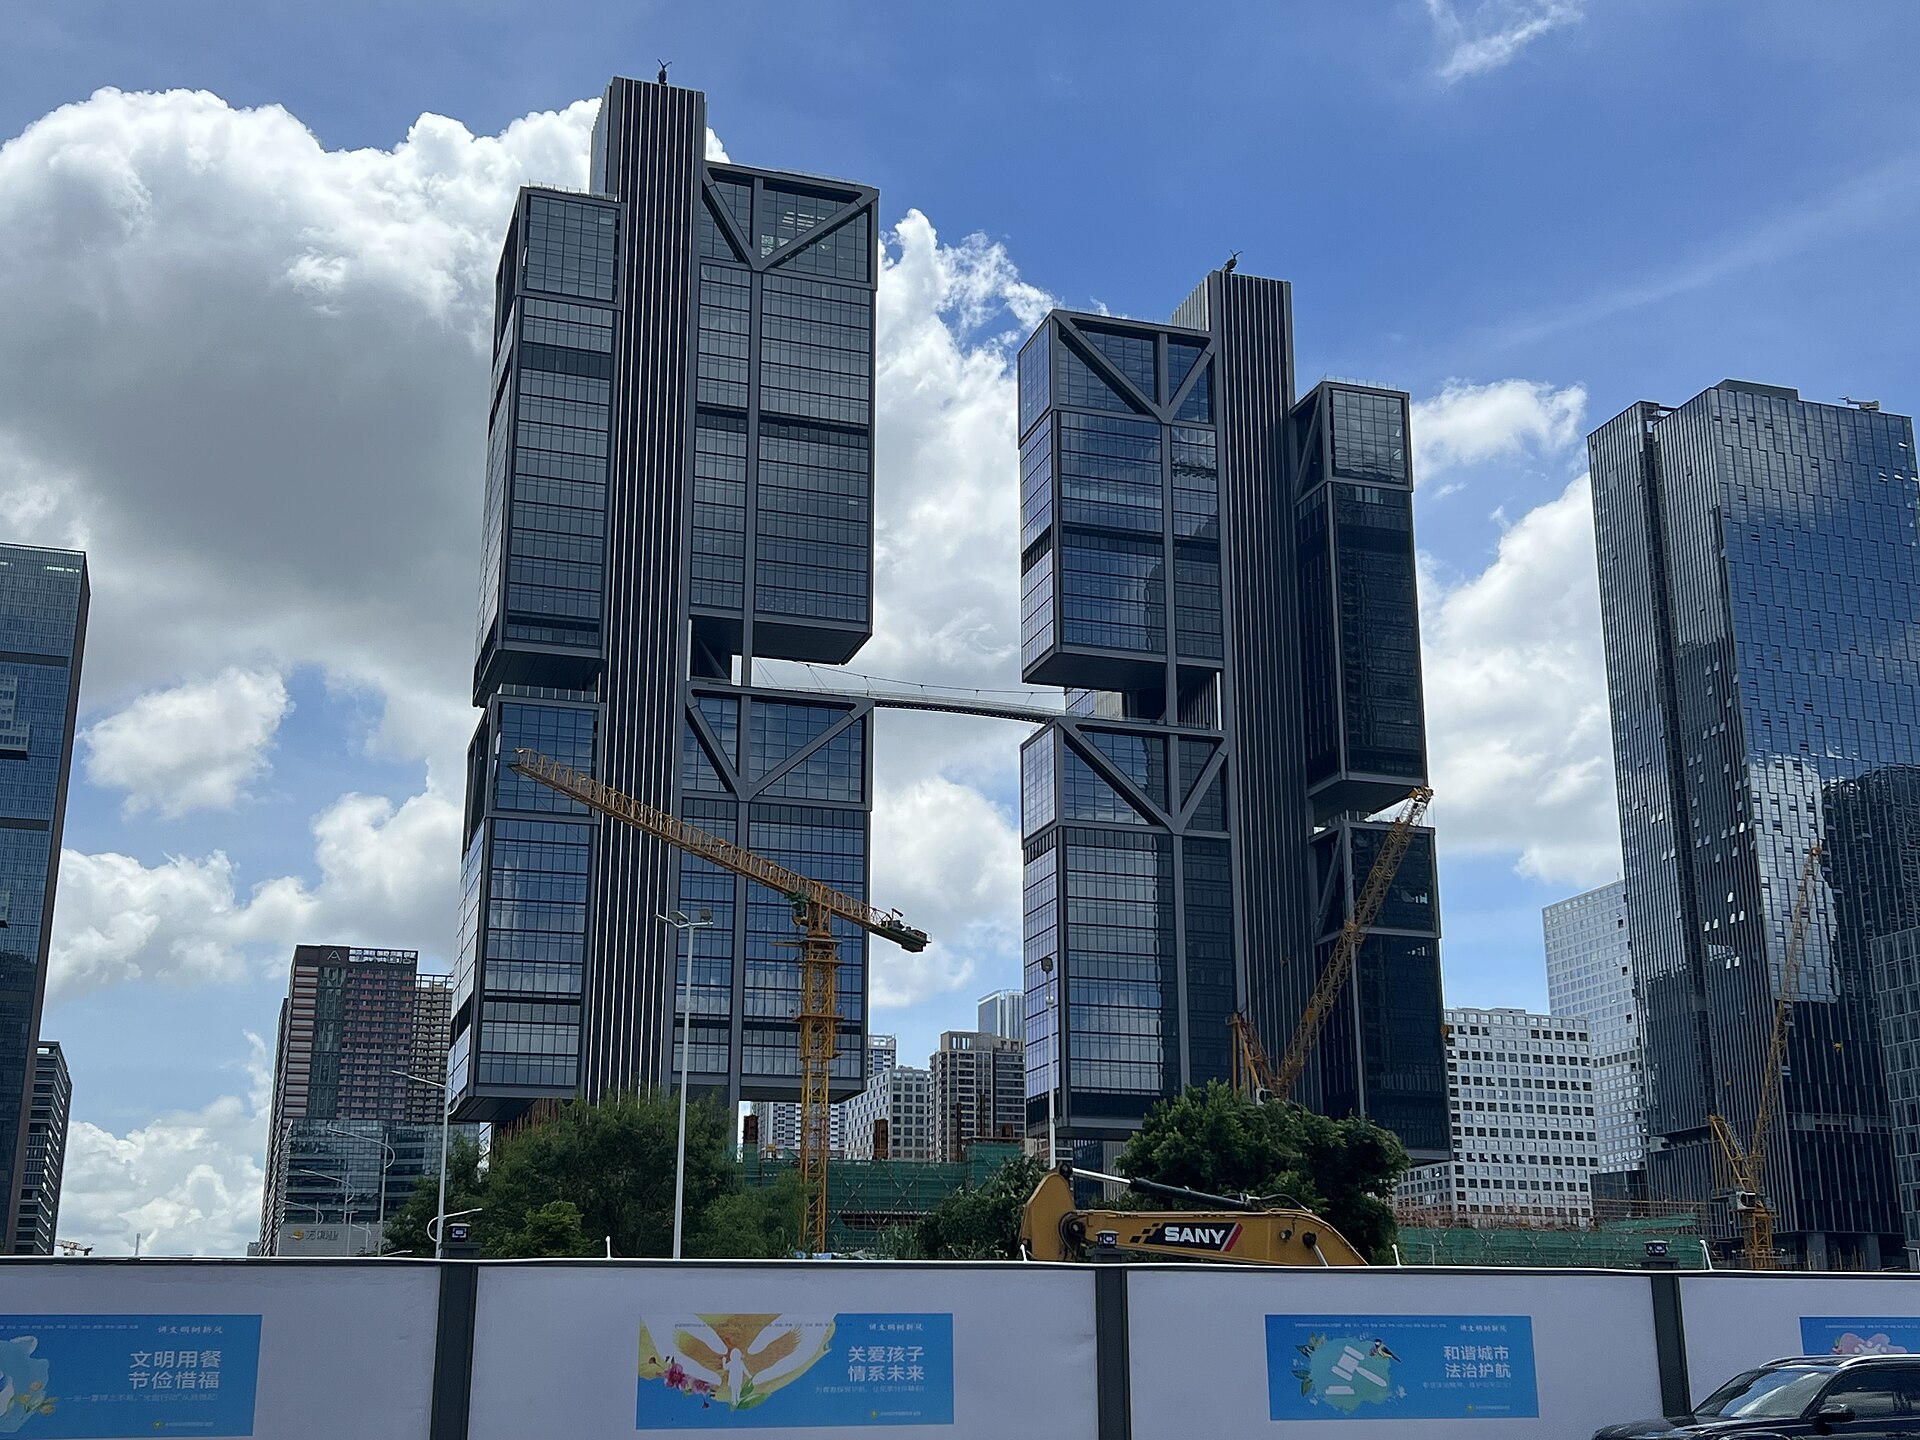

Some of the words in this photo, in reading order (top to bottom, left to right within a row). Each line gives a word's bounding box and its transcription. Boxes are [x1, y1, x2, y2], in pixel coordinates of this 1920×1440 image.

[1164, 1226, 1226, 1245] SANY
[129, 1350, 222, 1369] 文明用餐
[848, 1345, 925, 1363] 关爱孩子
[1443, 1345, 1510, 1361] 和谐城市
[847, 1364, 925, 1382] 情系未来
[1445, 1363, 1511, 1378] 法治护航
[128, 1371, 221, 1390] 节俭惜福
